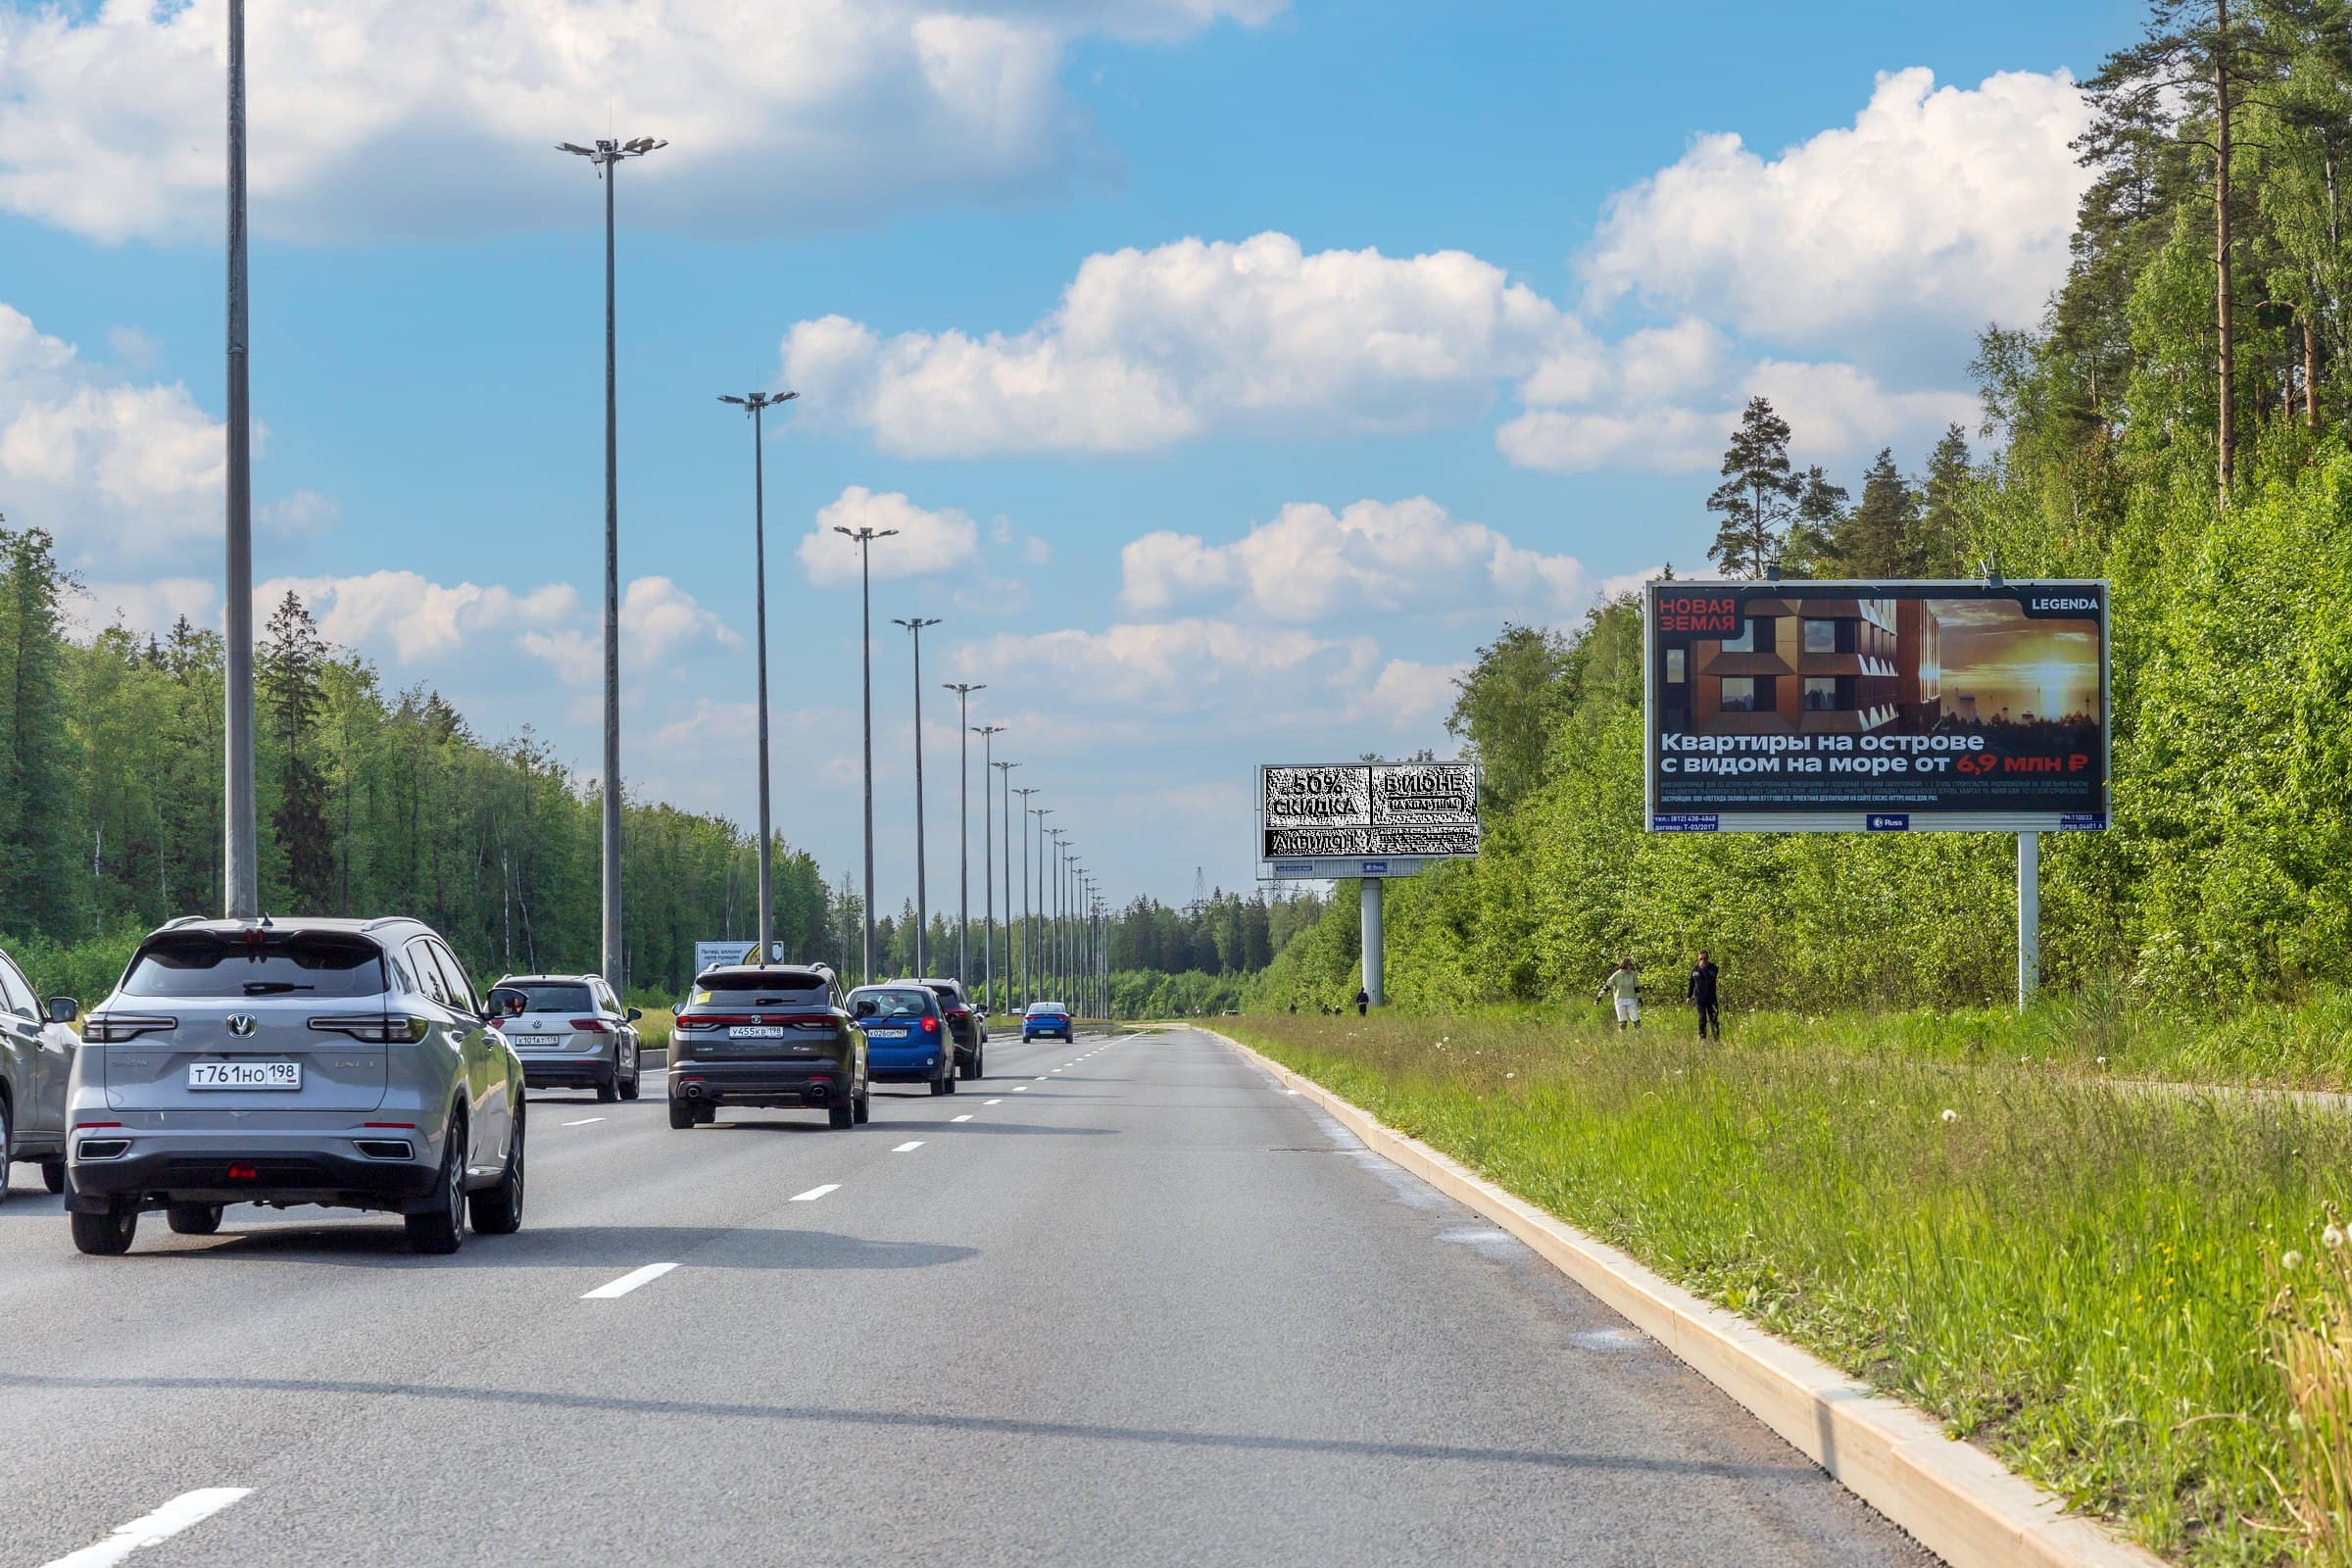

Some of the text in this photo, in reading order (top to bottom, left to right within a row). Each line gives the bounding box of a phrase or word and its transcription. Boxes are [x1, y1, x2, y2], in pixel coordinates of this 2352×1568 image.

[1659, 598, 1735, 614] НОВАЯ
[2032, 598, 2099, 610] LEGENDA
[1660, 615, 1736, 632] ЗЕМЛЯ
[1661, 733, 1984, 755] Квартиры на острове
[1660, 757, 1678, 773] с
[1684, 757, 1781, 775] видом
[1787, 757, 1823, 772] на
[1829, 757, 1908, 776] море
[1915, 757, 1951, 772] от
[1956, 753, 1998, 775] 6,9
[2003, 756, 2063, 772] млн
[1274, 798, 1359, 818] СКИДКА
[195, 1064, 294, 1083] Т761НО 198
